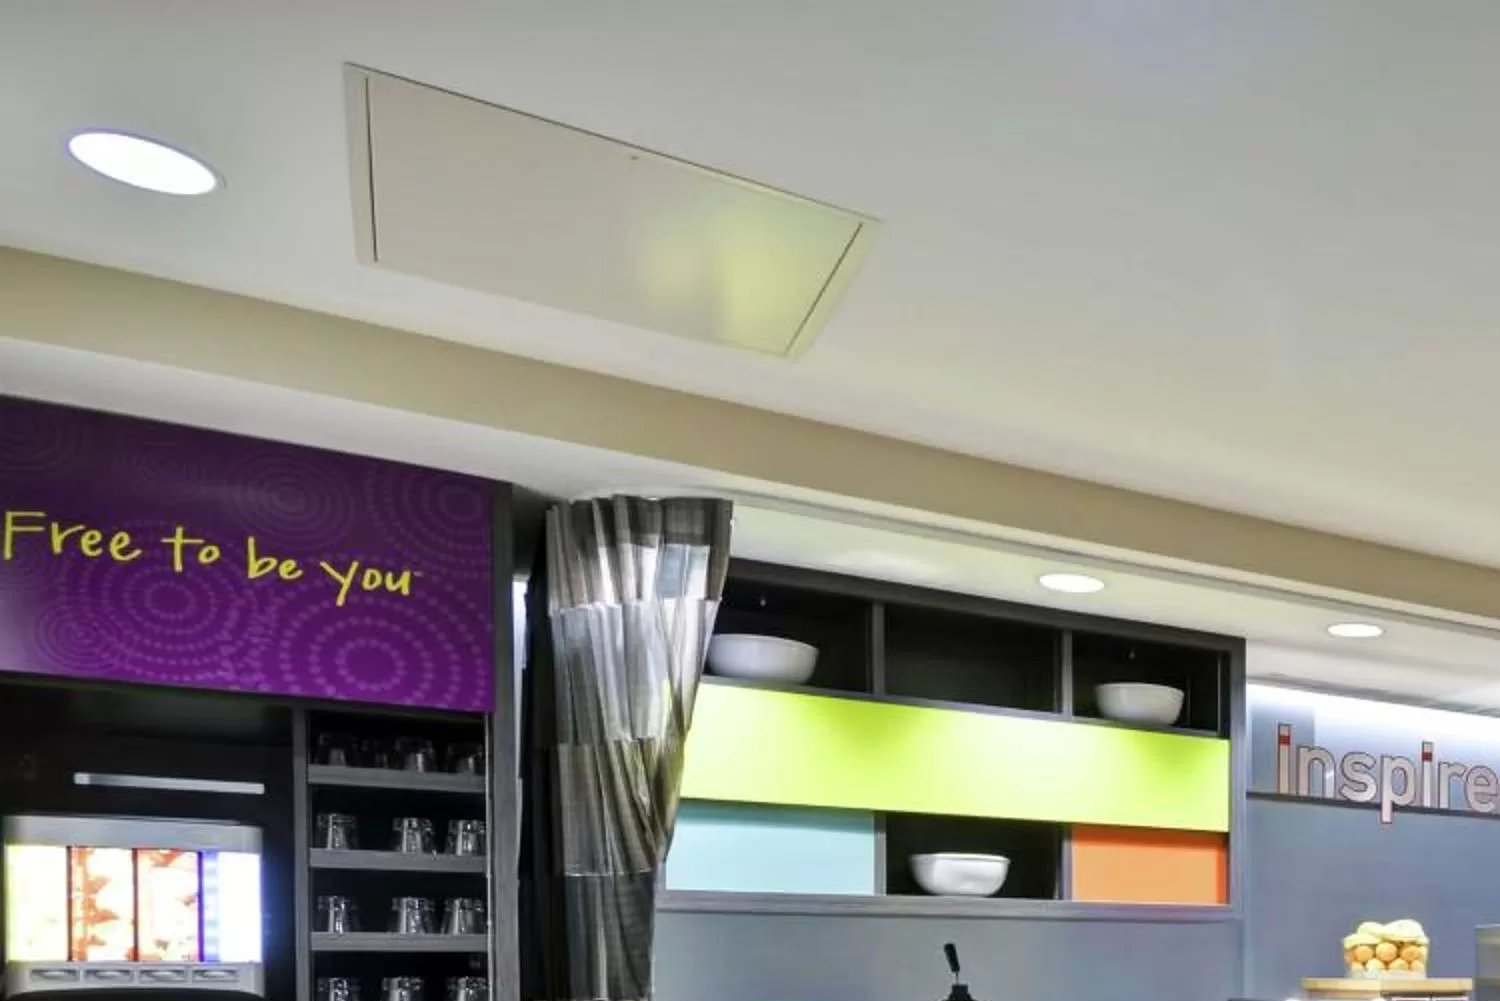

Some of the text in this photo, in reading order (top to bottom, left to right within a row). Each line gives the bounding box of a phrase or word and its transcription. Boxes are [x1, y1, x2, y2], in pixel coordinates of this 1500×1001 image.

[3, 511, 414, 607] Free to be you
